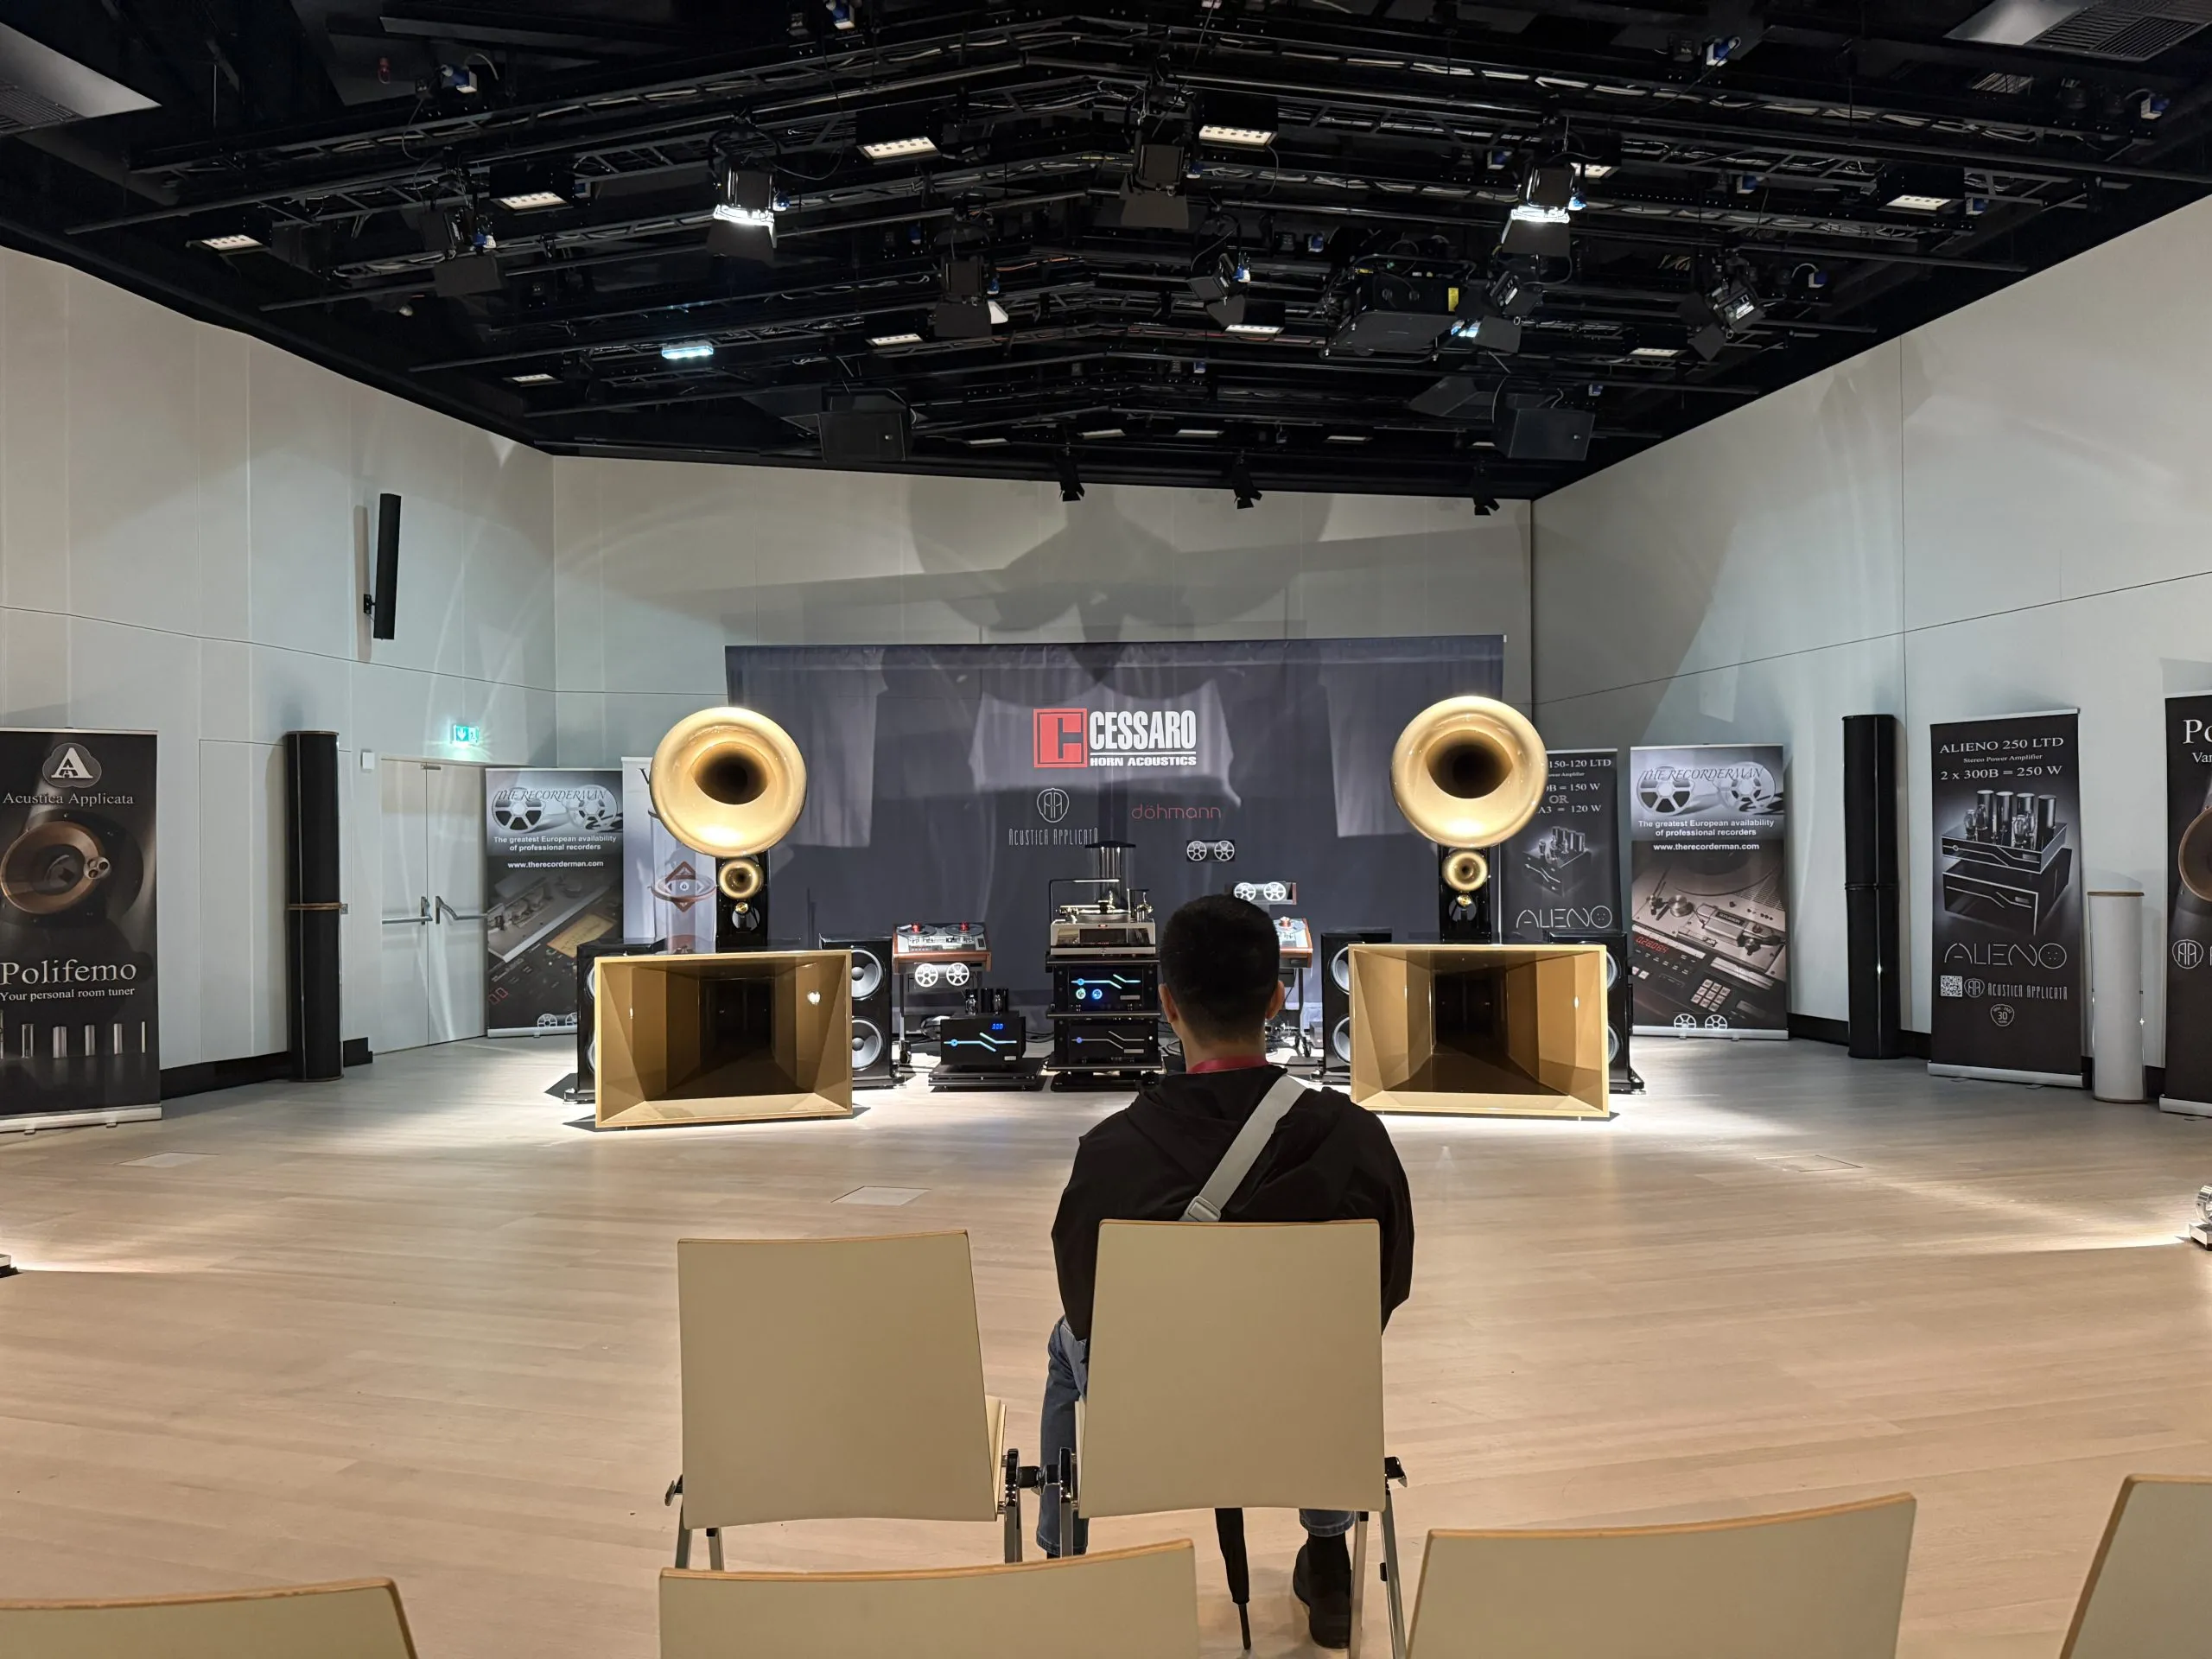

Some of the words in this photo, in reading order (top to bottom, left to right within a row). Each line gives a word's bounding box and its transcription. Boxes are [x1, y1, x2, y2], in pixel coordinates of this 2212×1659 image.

[1089, 709, 1197, 750] CESSARO
[1939, 741, 1999, 753] ALIENO
[2002, 739, 2028, 750] 250
[2032, 737, 2064, 748] LTD
[1090, 757, 1123, 766] HORN
[1127, 756, 1197, 766] ACOUSTICS
[2009, 753, 2043, 762] Amplifier
[1549, 760, 1587, 768] 150-120
[1590, 759, 1611, 767] LTD
[1643, 769, 1665, 780] THE
[1669, 767, 1764, 781] RECORDERMAN
[1940, 771, 1948, 780] 2
[1963, 768, 1999, 779] 300B
[2017, 766, 2042, 777] 250
[2046, 765, 2063, 775] W
[1570, 783, 1587, 791] 150
[3, 791, 64, 804] Acustica
[68, 791, 135, 807] Applicata
[498, 789, 518, 801] THE
[520, 789, 606, 802] RECORDERMAN
[1548, 795, 1569, 804] OR
[1131, 803, 1222, 820] döhmann
[1537, 805, 1552, 814] A3
[1571, 804, 1588, 813] 120
[1655, 820, 1688, 830] greatest
[1689, 819, 1729, 830] European
[1730, 818, 1775, 829] availability
[1008, 828, 1049, 845] ACUSTICA
[1665, 829, 1715, 838] professional
[1717, 828, 1757, 836] recorders
[509, 836, 540, 844] greatest
[541, 835, 576, 844] European
[578, 834, 617, 843] availability
[518, 843, 564, 853] professional
[566, 842, 601, 851] recorders
[1653, 842, 1760, 851] www.therecorderman.com
[507, 860, 604, 869] www.therecorderman.com
[0, 958, 137, 986] Polifemo
[0, 991, 27, 1001] Your
[30, 988, 75, 1002] personal
[78, 988, 105, 998] room
[108, 987, 135, 996] tuner
[1987, 982, 2023, 998] ACUSTICA
[2026, 985, 2068, 1001] APPLICATA
[1997, 1011, 2008, 1020] 30
